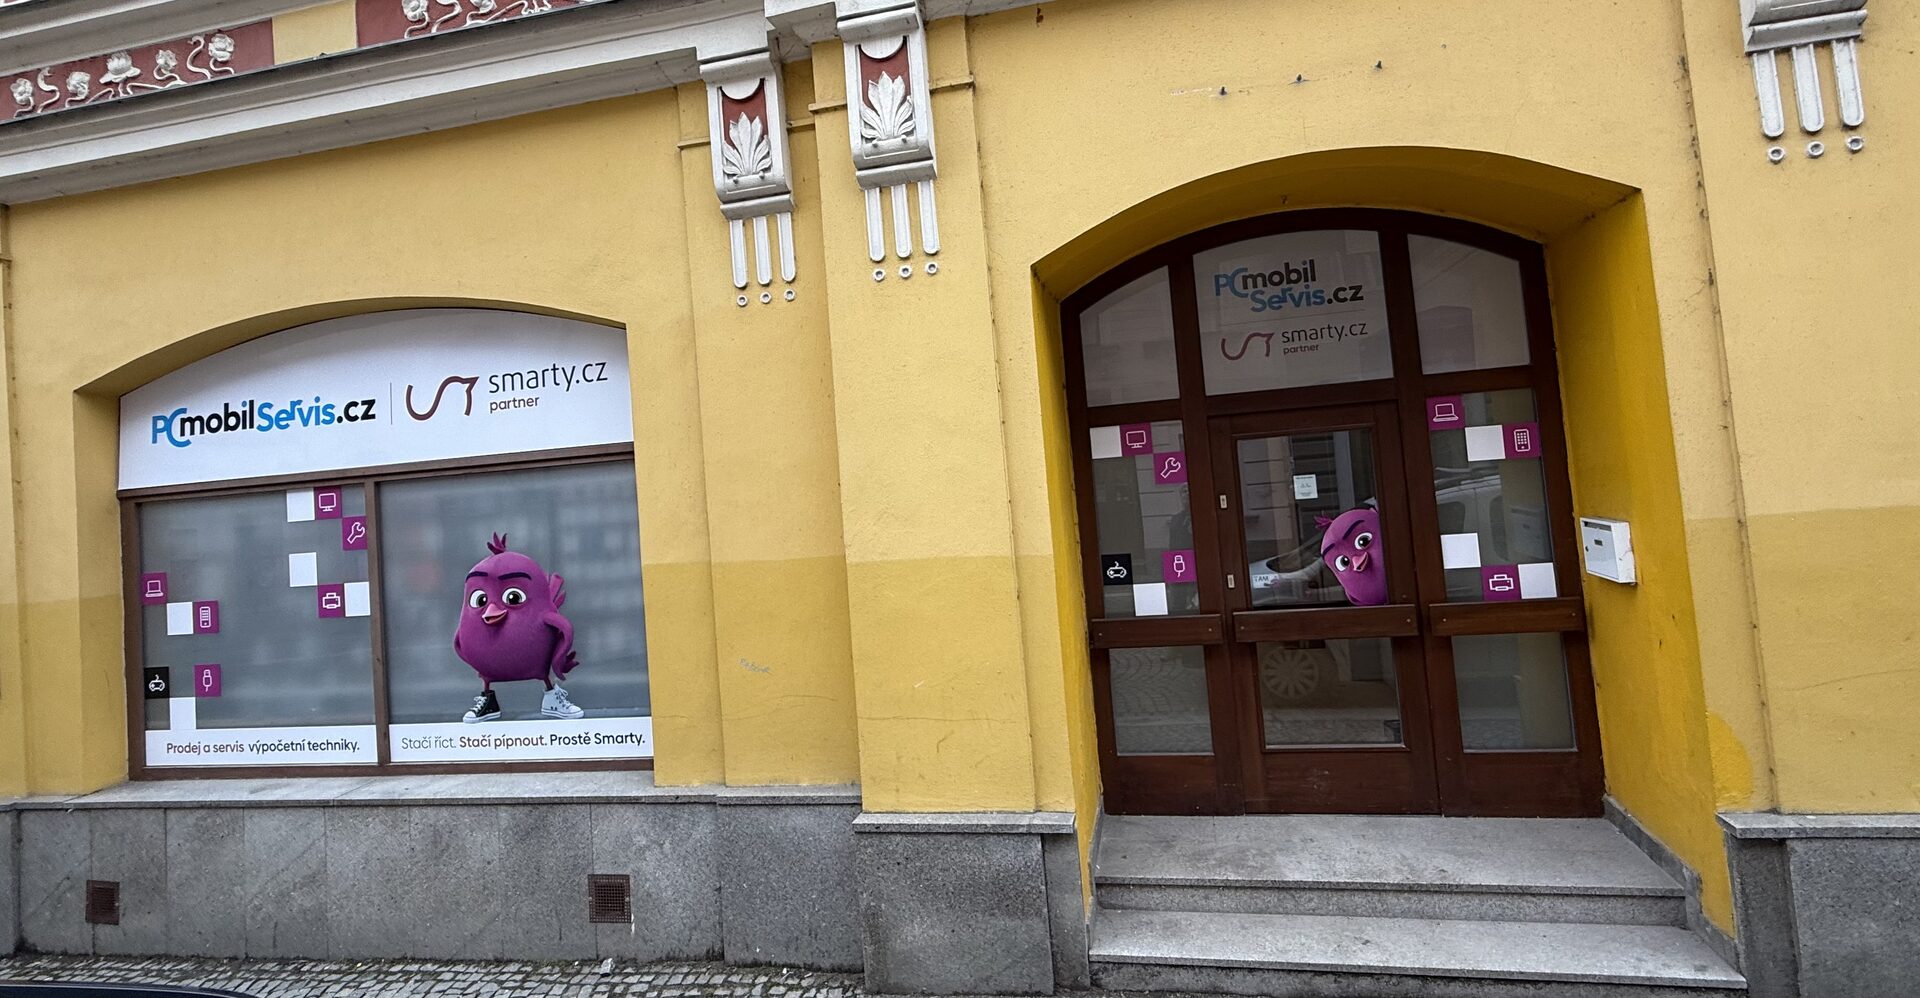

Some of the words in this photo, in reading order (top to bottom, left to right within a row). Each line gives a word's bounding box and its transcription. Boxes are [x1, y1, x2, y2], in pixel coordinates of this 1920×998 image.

[1214, 259, 1317, 298] PCmobil
[1250, 284, 1364, 312] Servis.cz
[1281, 322, 1368, 343] smarty.cz
[1283, 343, 1319, 355] partner
[489, 362, 608, 393] smarty.cz
[489, 396, 540, 414] partner
[152, 396, 376, 448] PCmobilServis.cz
[166, 741, 201, 755] Prodej
[203, 744, 211, 753] a
[213, 740, 245, 753] servis
[248, 739, 306, 754] výpočetní
[308, 739, 360, 753] techniky.
[401, 736, 432, 749] Stačí
[434, 736, 456, 749] říct.
[459, 734, 492, 748] Stačí
[494, 735, 547, 749] pípnout.
[550, 731, 591, 746] Prostě
[594, 732, 646, 746] Smarty.
